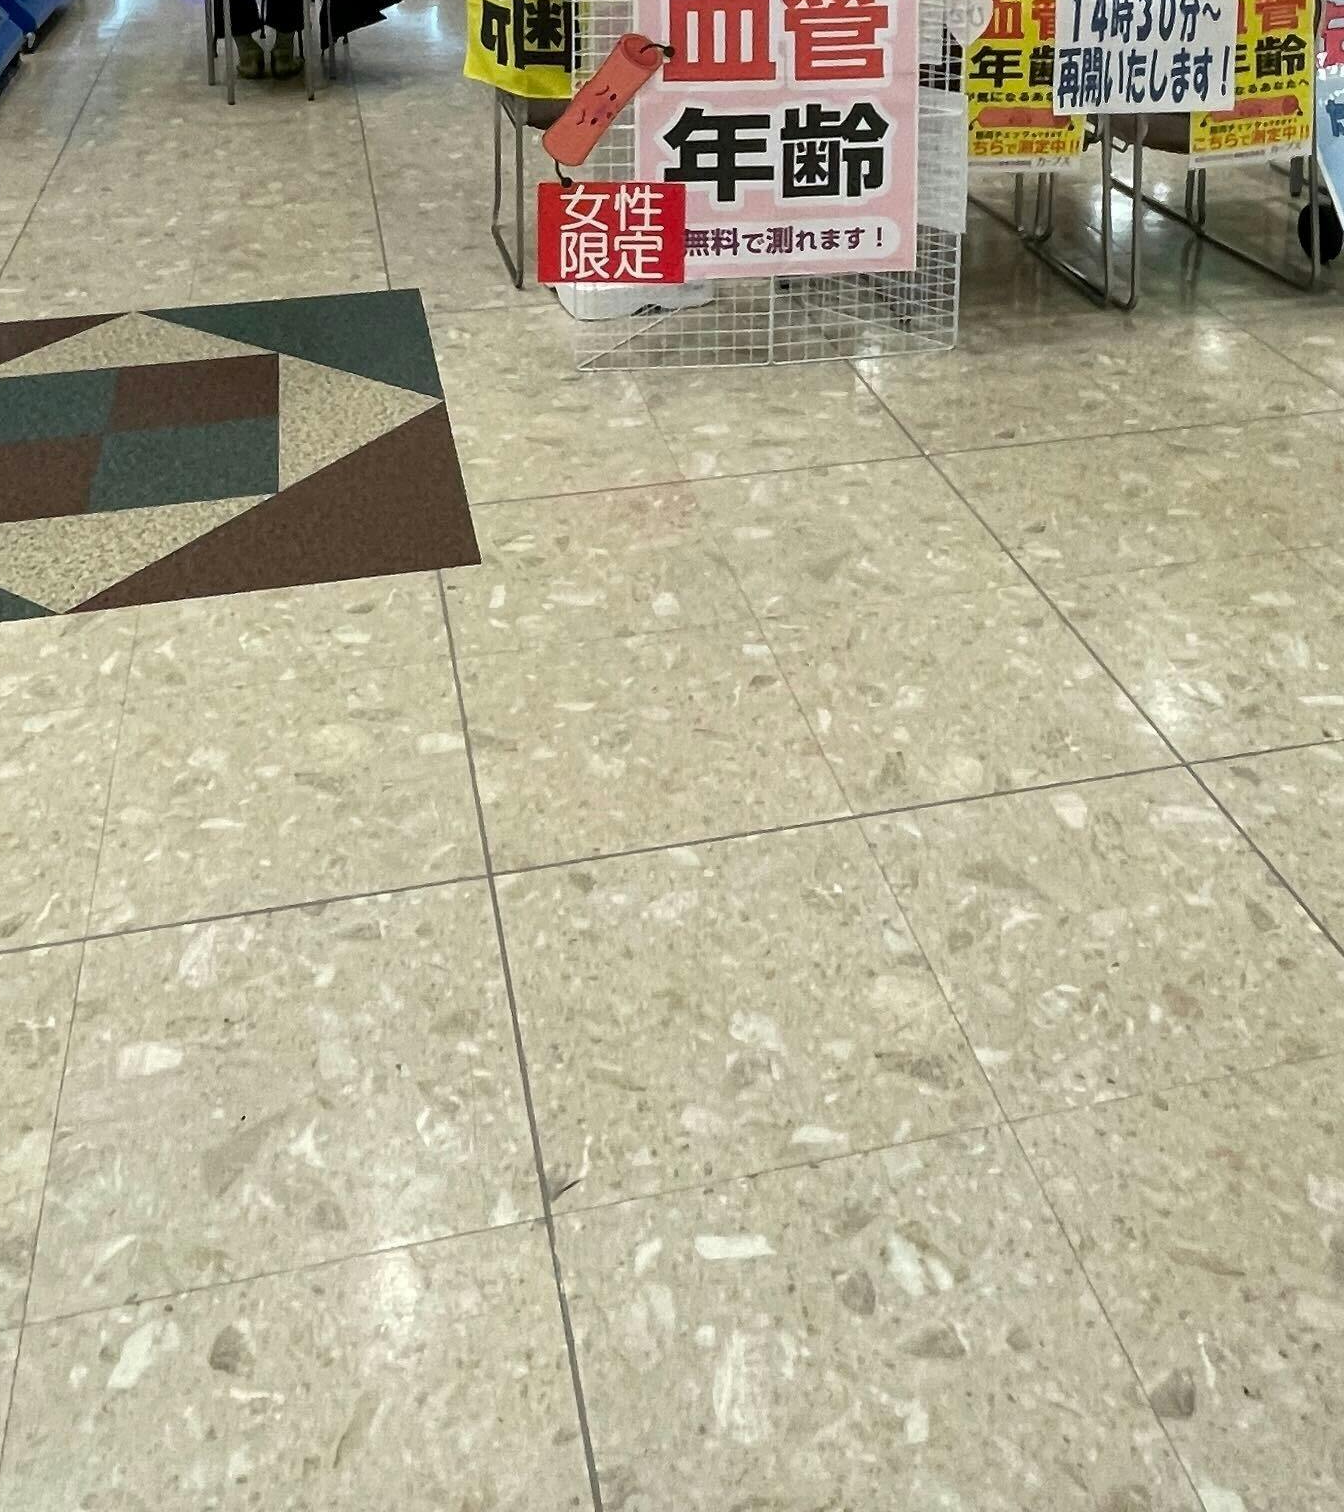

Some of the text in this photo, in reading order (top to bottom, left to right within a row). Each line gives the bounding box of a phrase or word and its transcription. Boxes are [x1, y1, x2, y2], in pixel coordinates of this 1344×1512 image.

[1056, 44, 1231, 108] 再開いたします!
[662, 101, 889, 203] 年齢
[559, 184, 665, 232] 女性
[559, 231, 665, 280] 限定
[683, 225, 883, 257] 無料で測れます!
